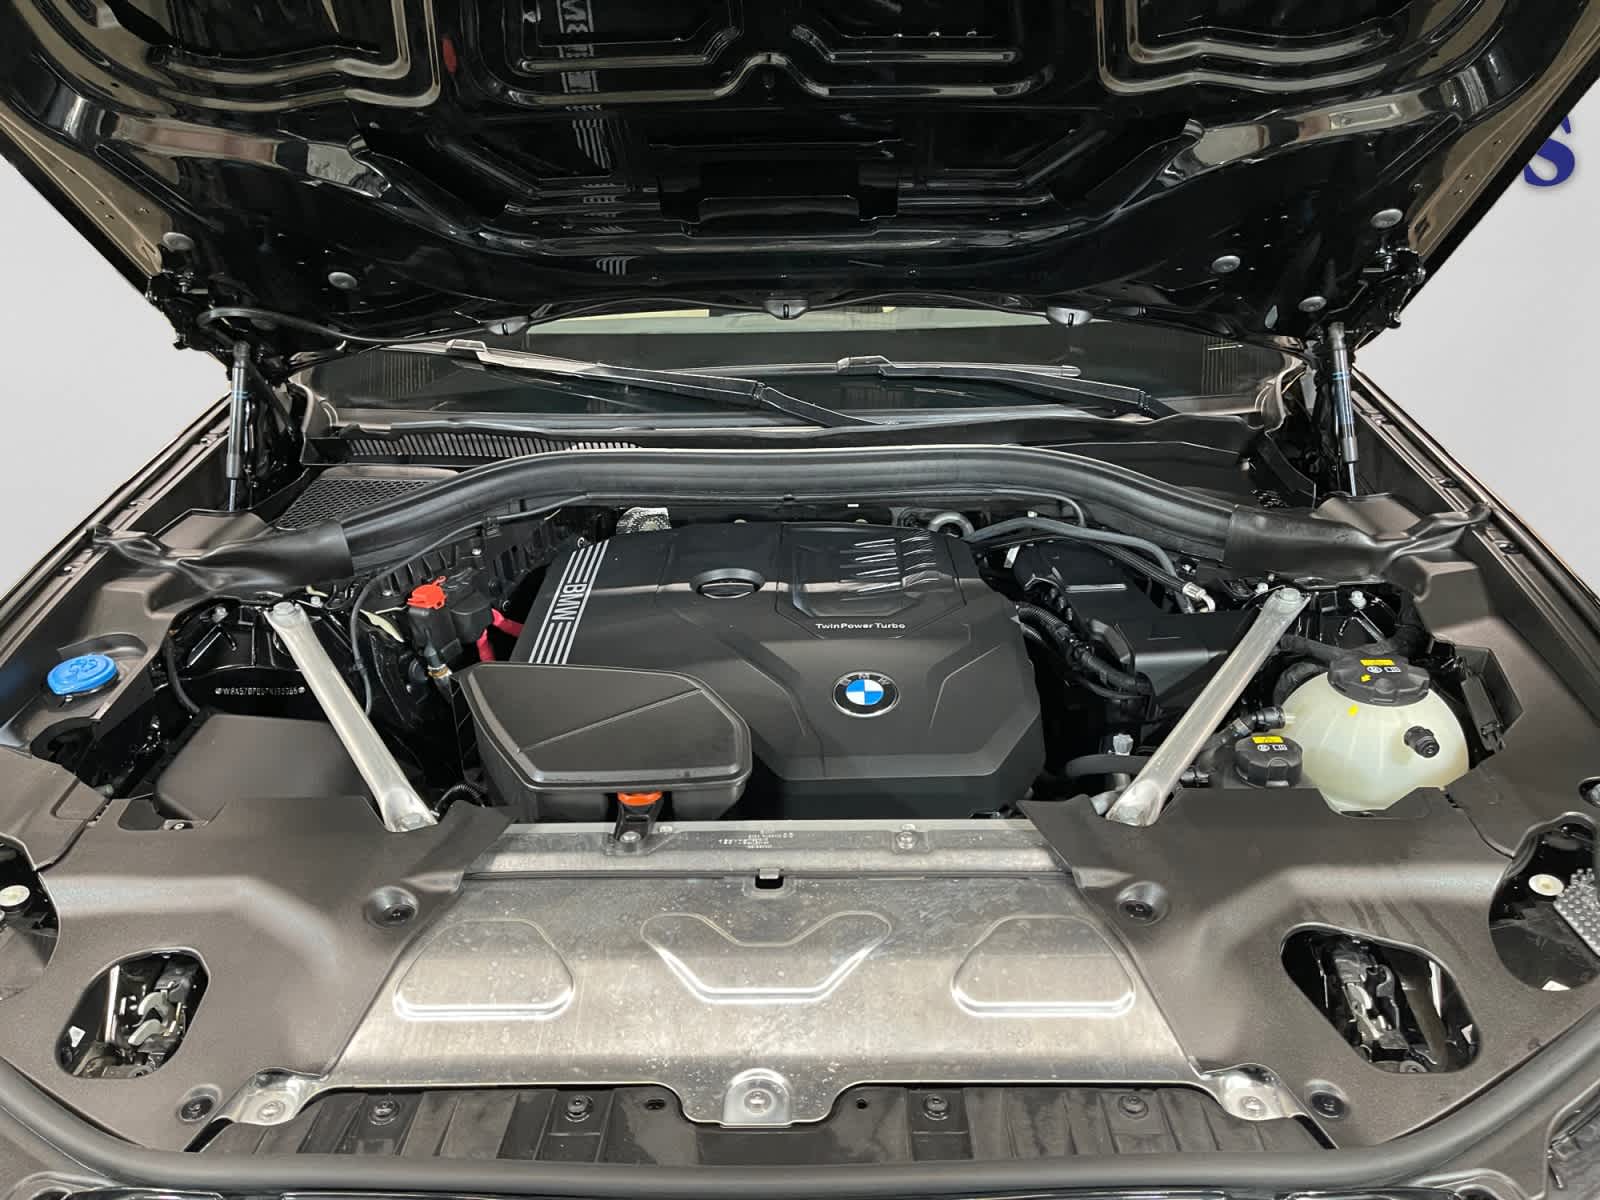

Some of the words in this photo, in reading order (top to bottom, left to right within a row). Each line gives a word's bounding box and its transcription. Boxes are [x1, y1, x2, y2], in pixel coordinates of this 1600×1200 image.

[551, 583, 588, 620] BMW
[815, 622, 874, 630] TwinPower
[874, 622, 906, 630] Turbo
